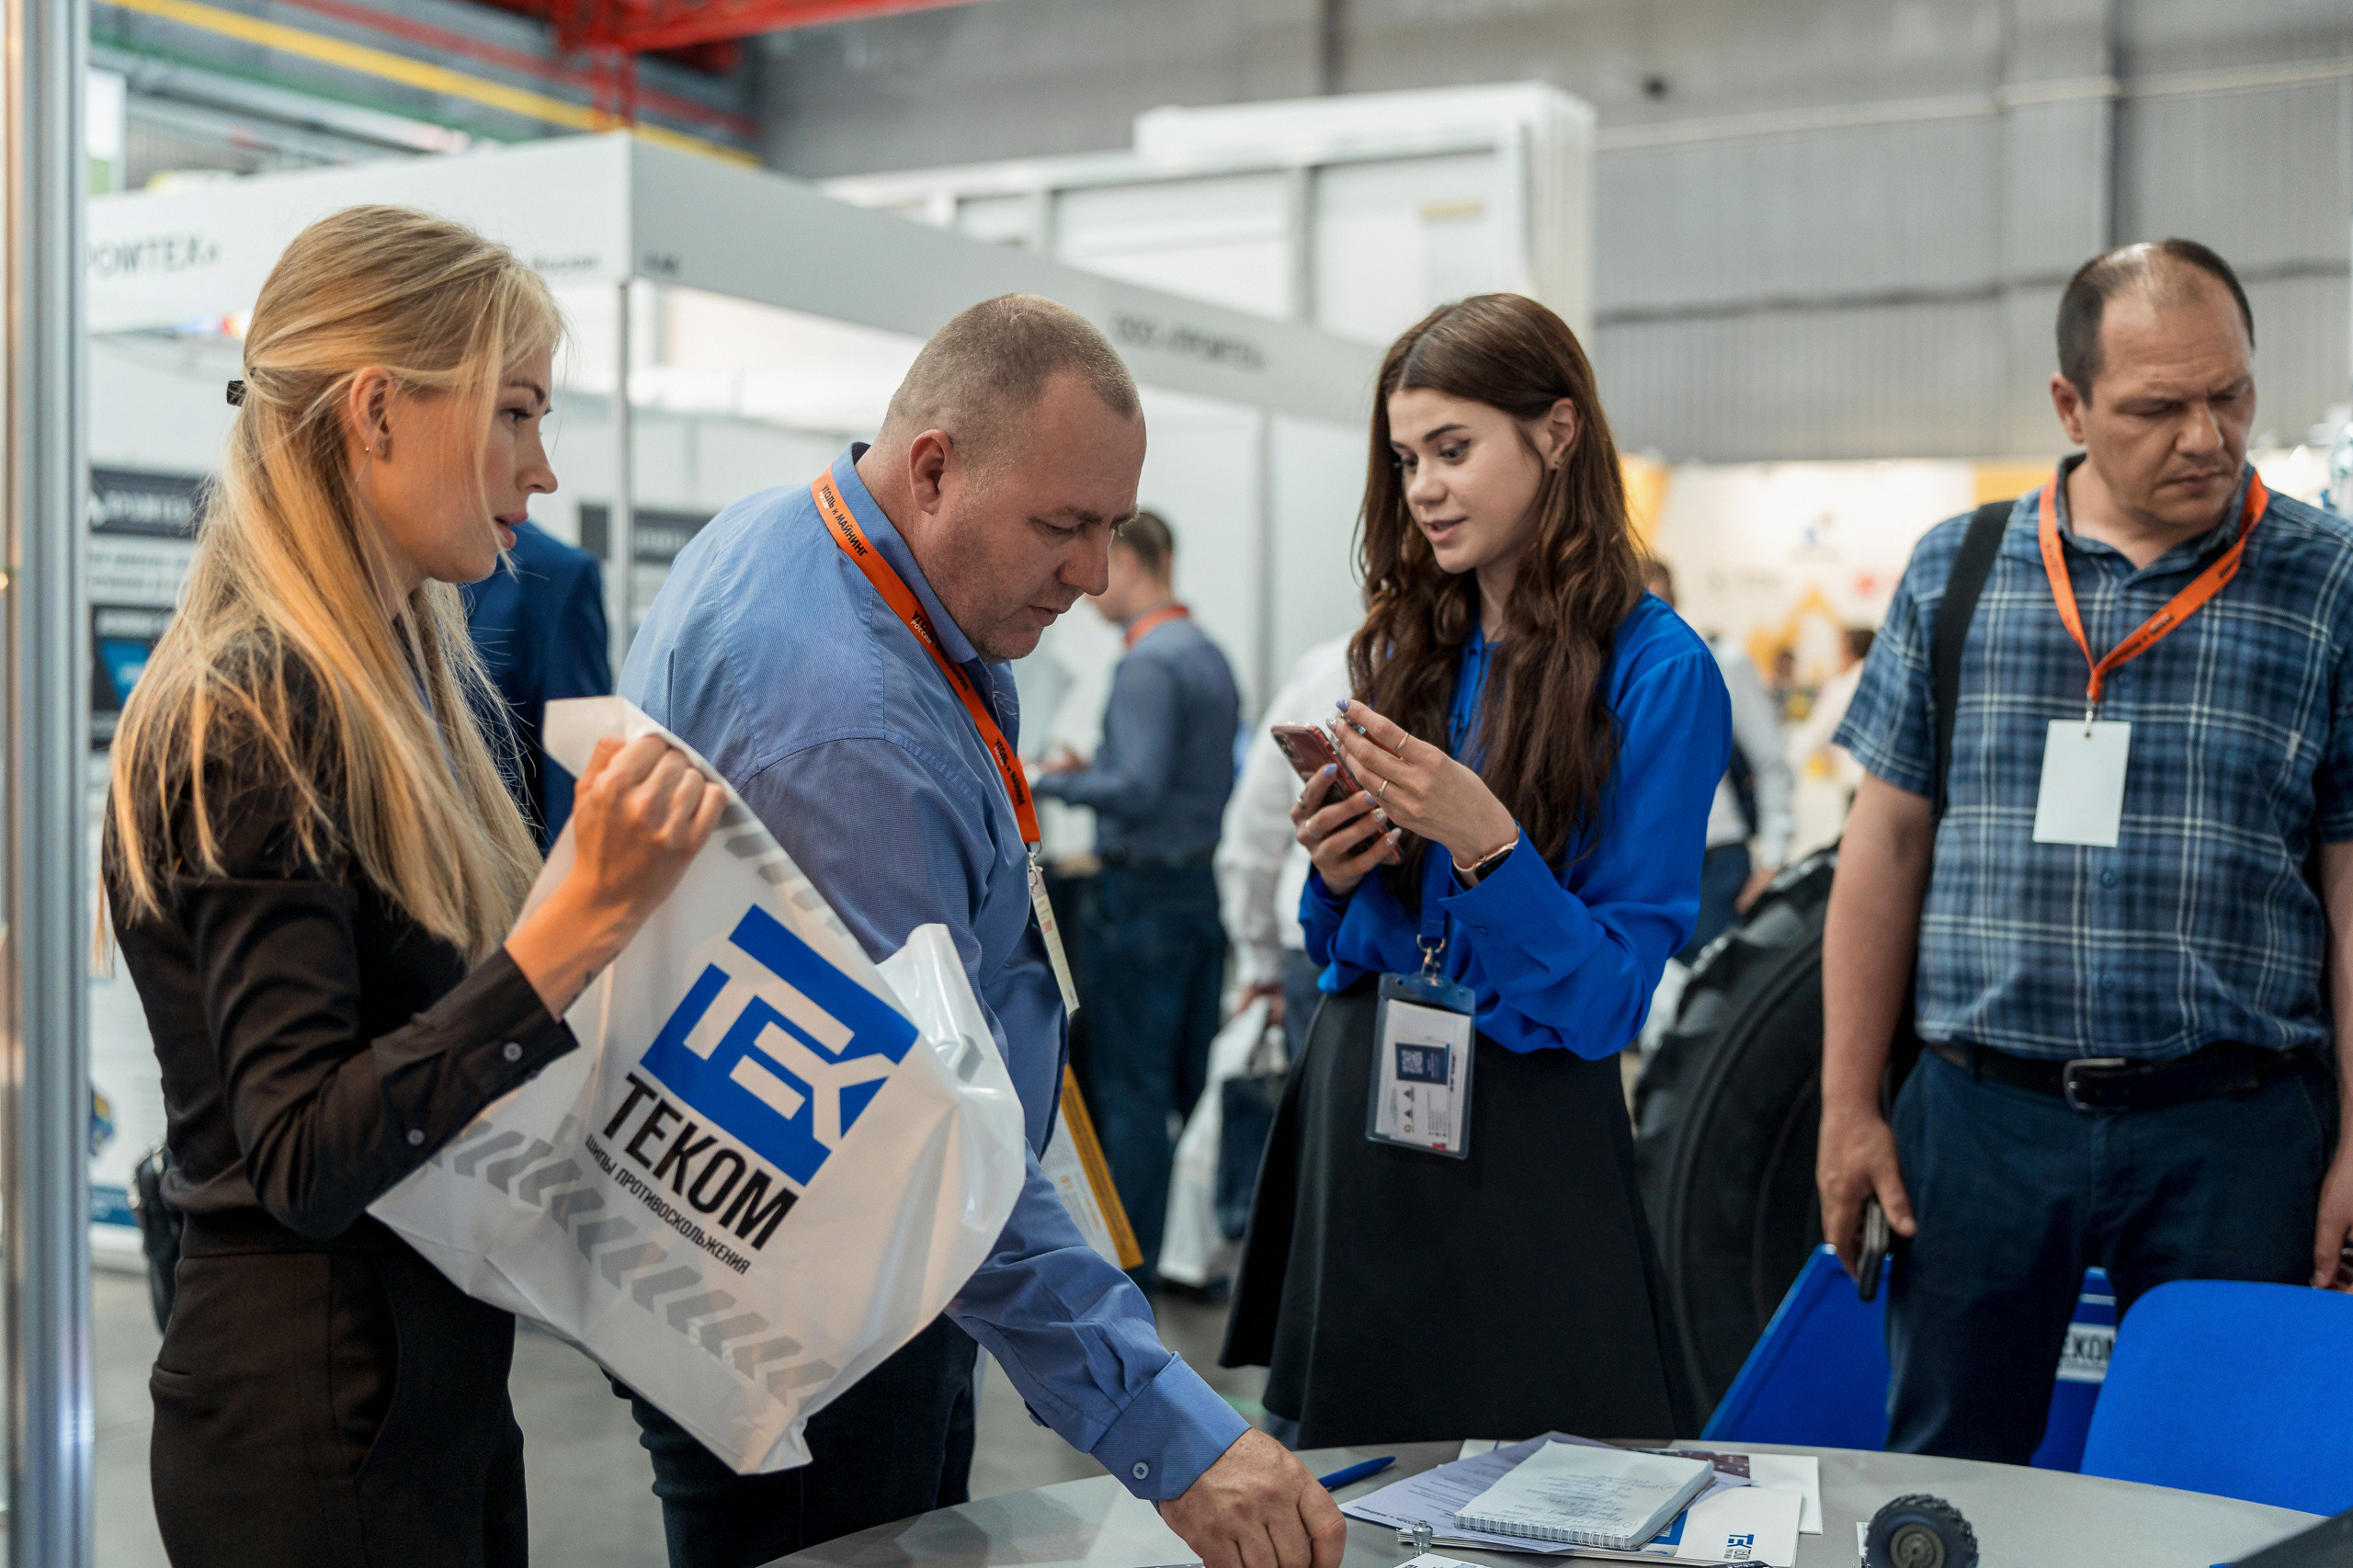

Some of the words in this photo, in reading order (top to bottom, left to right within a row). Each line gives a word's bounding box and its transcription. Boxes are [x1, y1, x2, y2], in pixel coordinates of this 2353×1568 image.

[821, 484, 835, 508] УГОЛЬ
[835, 513, 868, 557] МАЙНИНГ
[910, 619, 932, 644] РОССИИ
[585, 1133, 618, 1176] ШИПЫ
[614, 1167, 752, 1275] ПРОТИВОСКОЛЬЖЕНИЯ
[603, 1072, 800, 1251] ТЕКОМ
